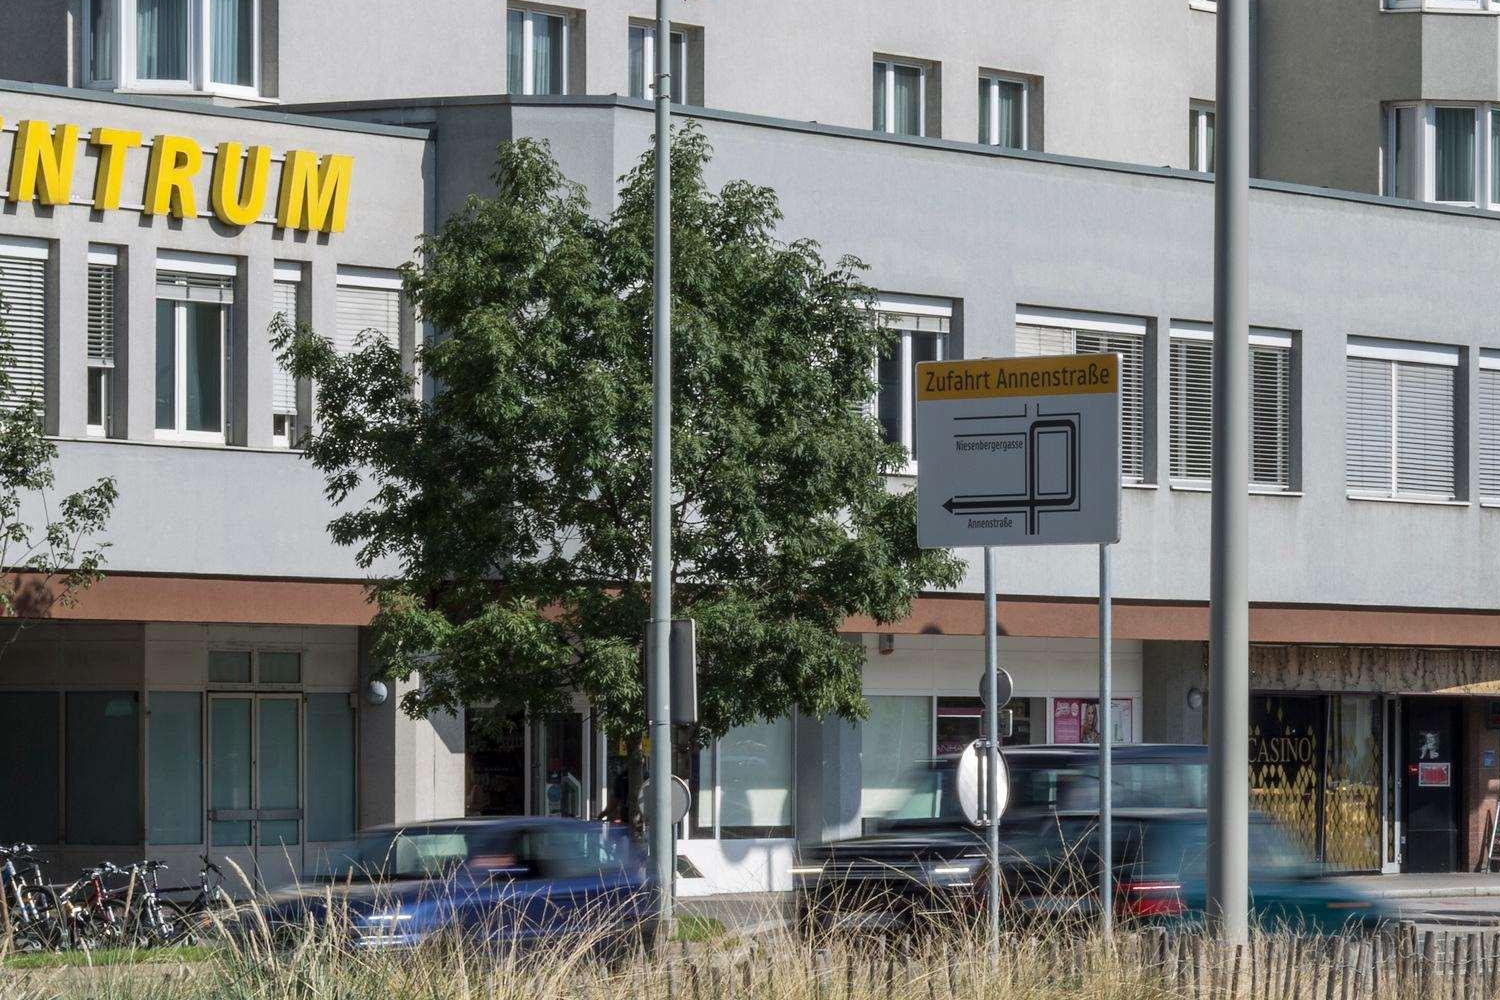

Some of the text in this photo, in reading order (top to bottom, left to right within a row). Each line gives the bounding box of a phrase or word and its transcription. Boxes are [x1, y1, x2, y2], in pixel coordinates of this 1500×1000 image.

[0, 115, 354, 233] NTRUM
[925, 363, 1110, 393] Zufahrt Annenstraße
[955, 440, 1023, 452] Niesenbergergasse
[967, 518, 1013, 529] Annenstraße
[1248, 737, 1312, 763] CASINO
